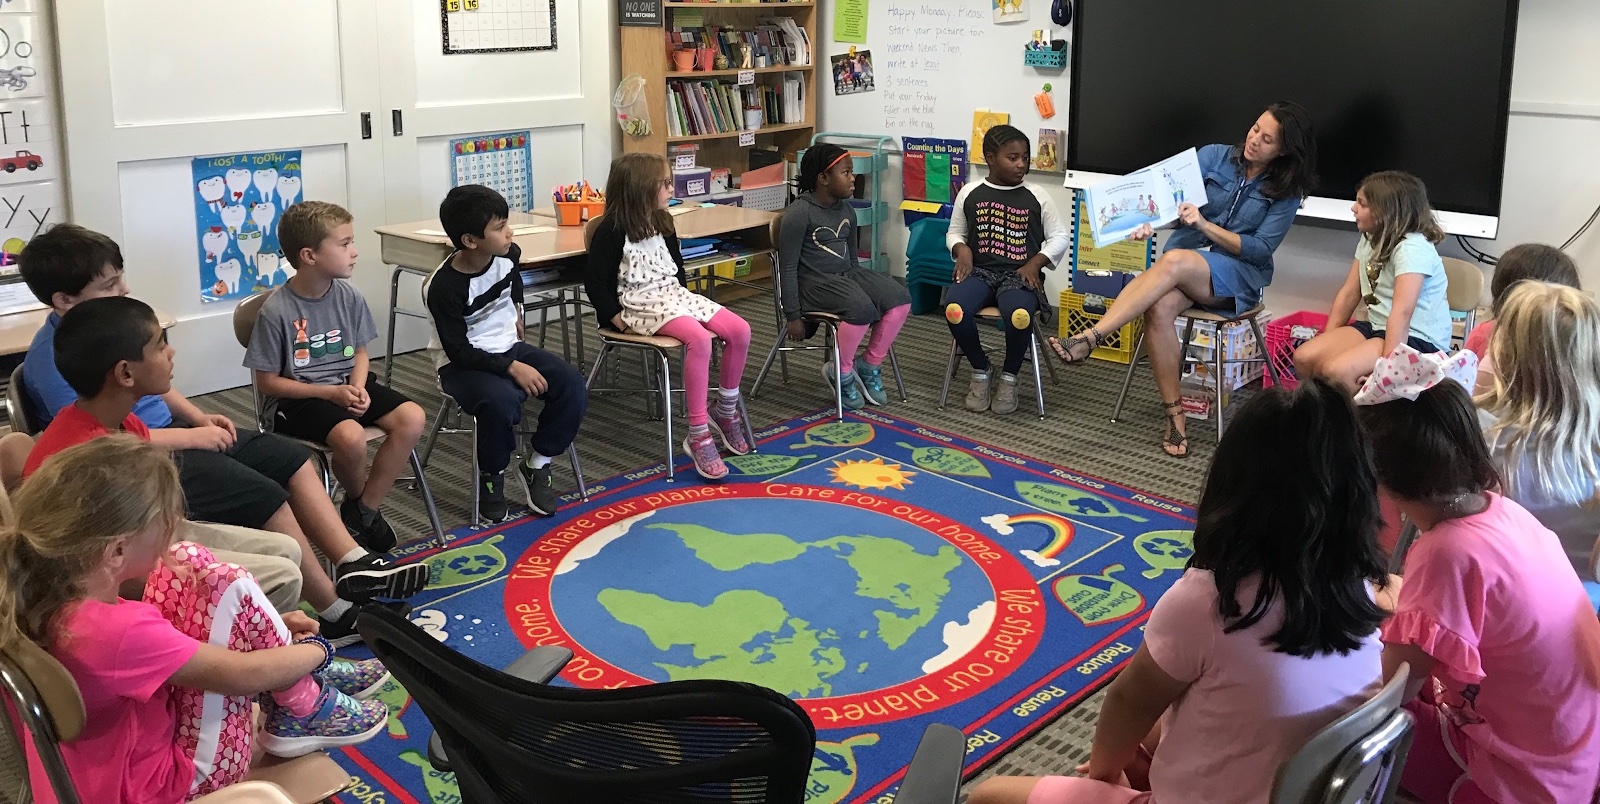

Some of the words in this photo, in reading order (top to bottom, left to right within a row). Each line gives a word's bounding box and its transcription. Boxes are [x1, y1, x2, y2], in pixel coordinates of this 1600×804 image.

[449, 1, 459, 10] 15
[467, 0, 477, 8] 16
[625, 1, 639, 12] NO
[639, 1, 656, 12] ONE
[887, 2, 916, 21] Happy
[958, 5, 985, 19] Please
[888, 25, 910, 36] Start
[913, 27, 932, 39] your
[935, 26, 966, 39] picture
[969, 25, 985, 37] for
[910, 58, 919, 69] at
[924, 57, 941, 69] least
[886, 75, 892, 88] 3
[896, 76, 929, 87] sentences
[883, 90, 896, 100] Put
[898, 94, 912, 104] your
[916, 91, 937, 106] Friday
[911, 104, 921, 114] the
[922, 104, 935, 114] blue
[885, 118, 896, 129] bin
[898, 120, 907, 128] on
[909, 117, 919, 128] the
[906, 142, 934, 153] Counting
[934, 144, 946, 153] the
[947, 145, 964, 155] Days
[208, 160, 211, 168] I
[213, 156, 236, 167] LOST
[240, 155, 248, 163] A
[252, 153, 286, 165] TOOTH!
[953, 166, 958, 174] 9
[975, 208, 989, 216] YAY
[990, 209, 1005, 218] FOR
[1006, 213, 1029, 222] TODAY
[990, 202, 1005, 210] FOR
[1006, 206, 1030, 215] TODAY
[990, 216, 1005, 226] FOR
[1006, 221, 1029, 230] TODAY
[990, 224, 1005, 234] FOR
[1006, 229, 1028, 238] TODAY
[990, 232, 1005, 241] FOR
[1006, 236, 1027, 245] TODAY
[990, 240, 1005, 249] FOR
[1006, 244, 1027, 253] TODAY
[1079, 245, 1094, 253] Infer
[990, 247, 1005, 257] FOR
[1006, 252, 1028, 261] TODAY
[1078, 258, 1100, 268] Connect
[753, 425, 790, 439] Reuse
[912, 426, 953, 443] Reuse
[973, 445, 1027, 466] Recycle
[767, 456, 792, 464] the
[1030, 484, 1068, 498] Plant
[1048, 468, 1106, 490] Reduce
[1131, 493, 1184, 514] Reuse
[765, 483, 836, 499] Care
[840, 491, 889, 509] for
[892, 504, 941, 526] our
[936, 523, 1003, 565] home.
[511, 555, 553, 580] We
[538, 518, 596, 554] share
[595, 500, 638, 520] our
[644, 485, 738, 507] planet.
[387, 534, 457, 558] Recyce
[999, 588, 1040, 615] We
[1083, 606, 1112, 621] from
[984, 615, 1036, 664] share
[1075, 641, 1134, 675] Reduce
[567, 654, 604, 682] ou
[943, 662, 995, 693] our
[810, 683, 941, 723] planet.
[1012, 685, 1068, 717] Reuse
